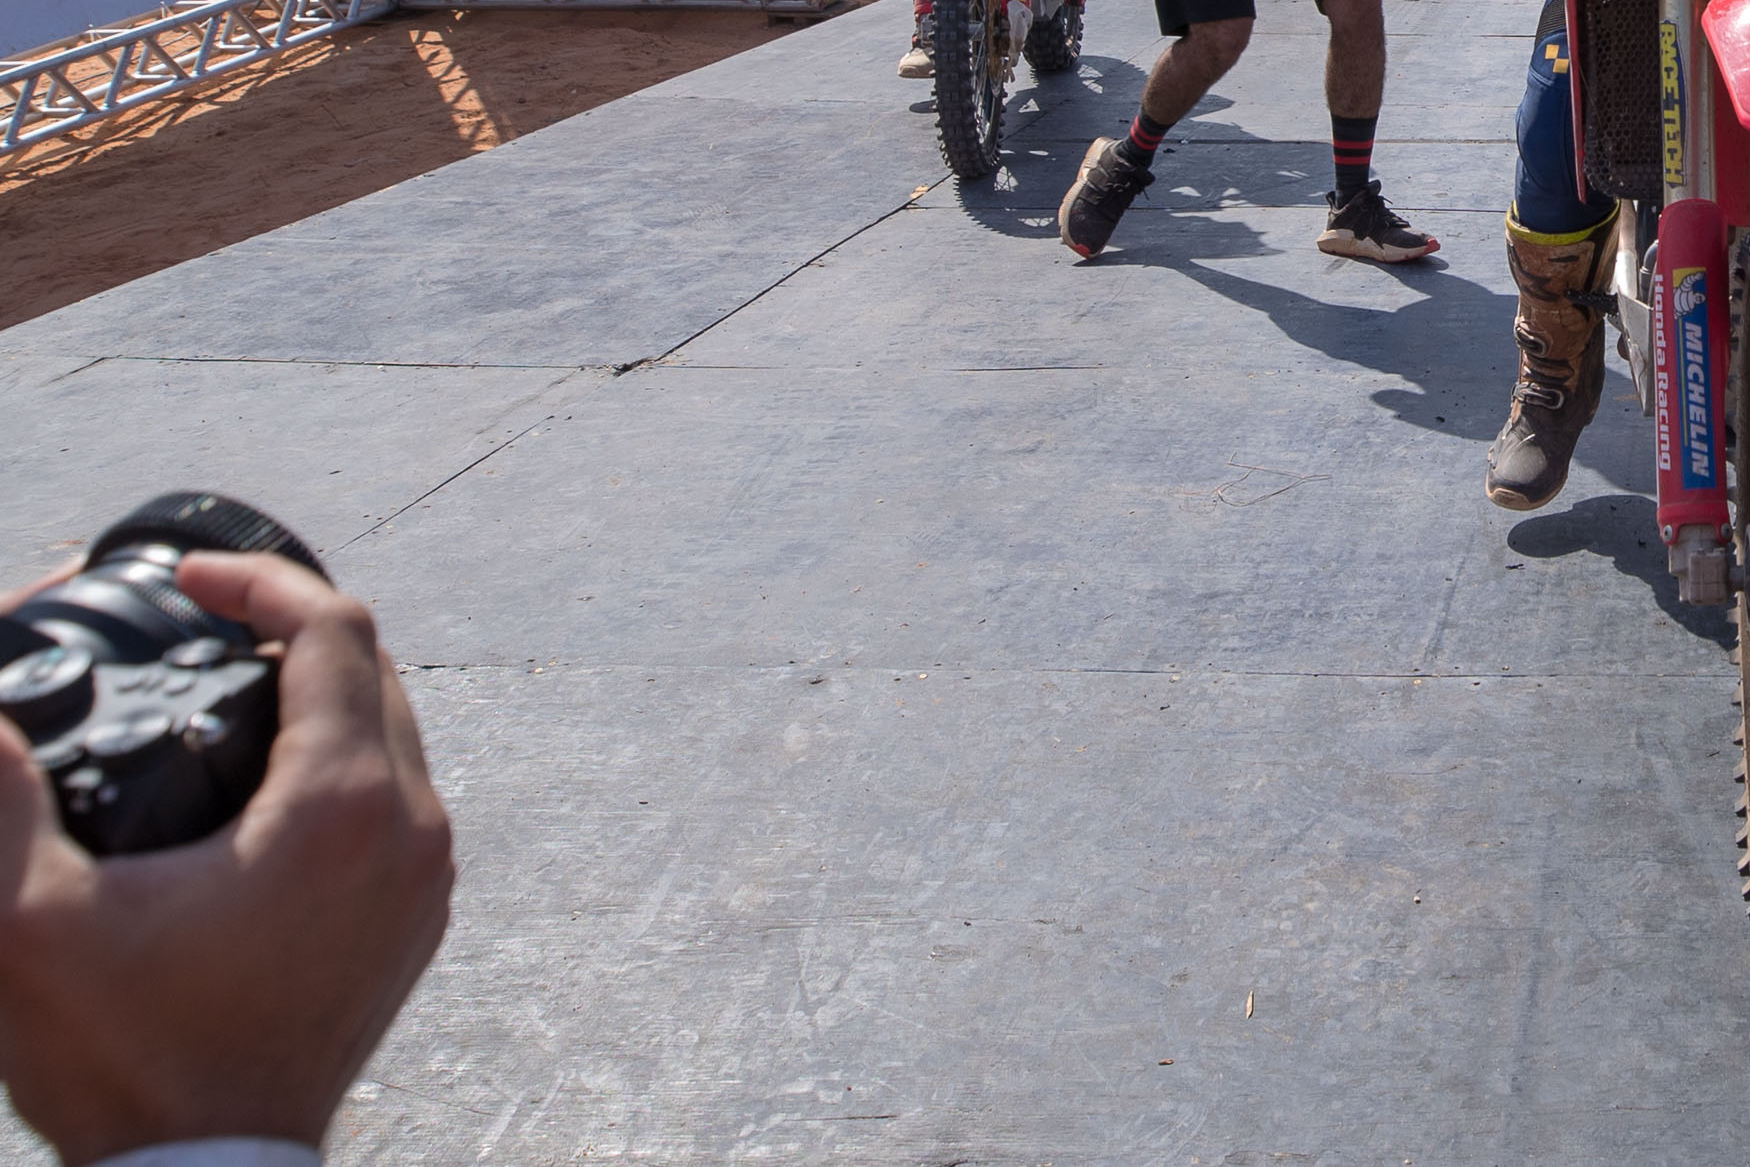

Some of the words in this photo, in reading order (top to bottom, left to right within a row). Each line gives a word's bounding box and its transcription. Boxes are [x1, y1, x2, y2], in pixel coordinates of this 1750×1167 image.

[1654, 274, 1667, 366] Honda
[1657, 371, 1671, 471] Racing
[1685, 321, 1710, 478] MICHELIN
